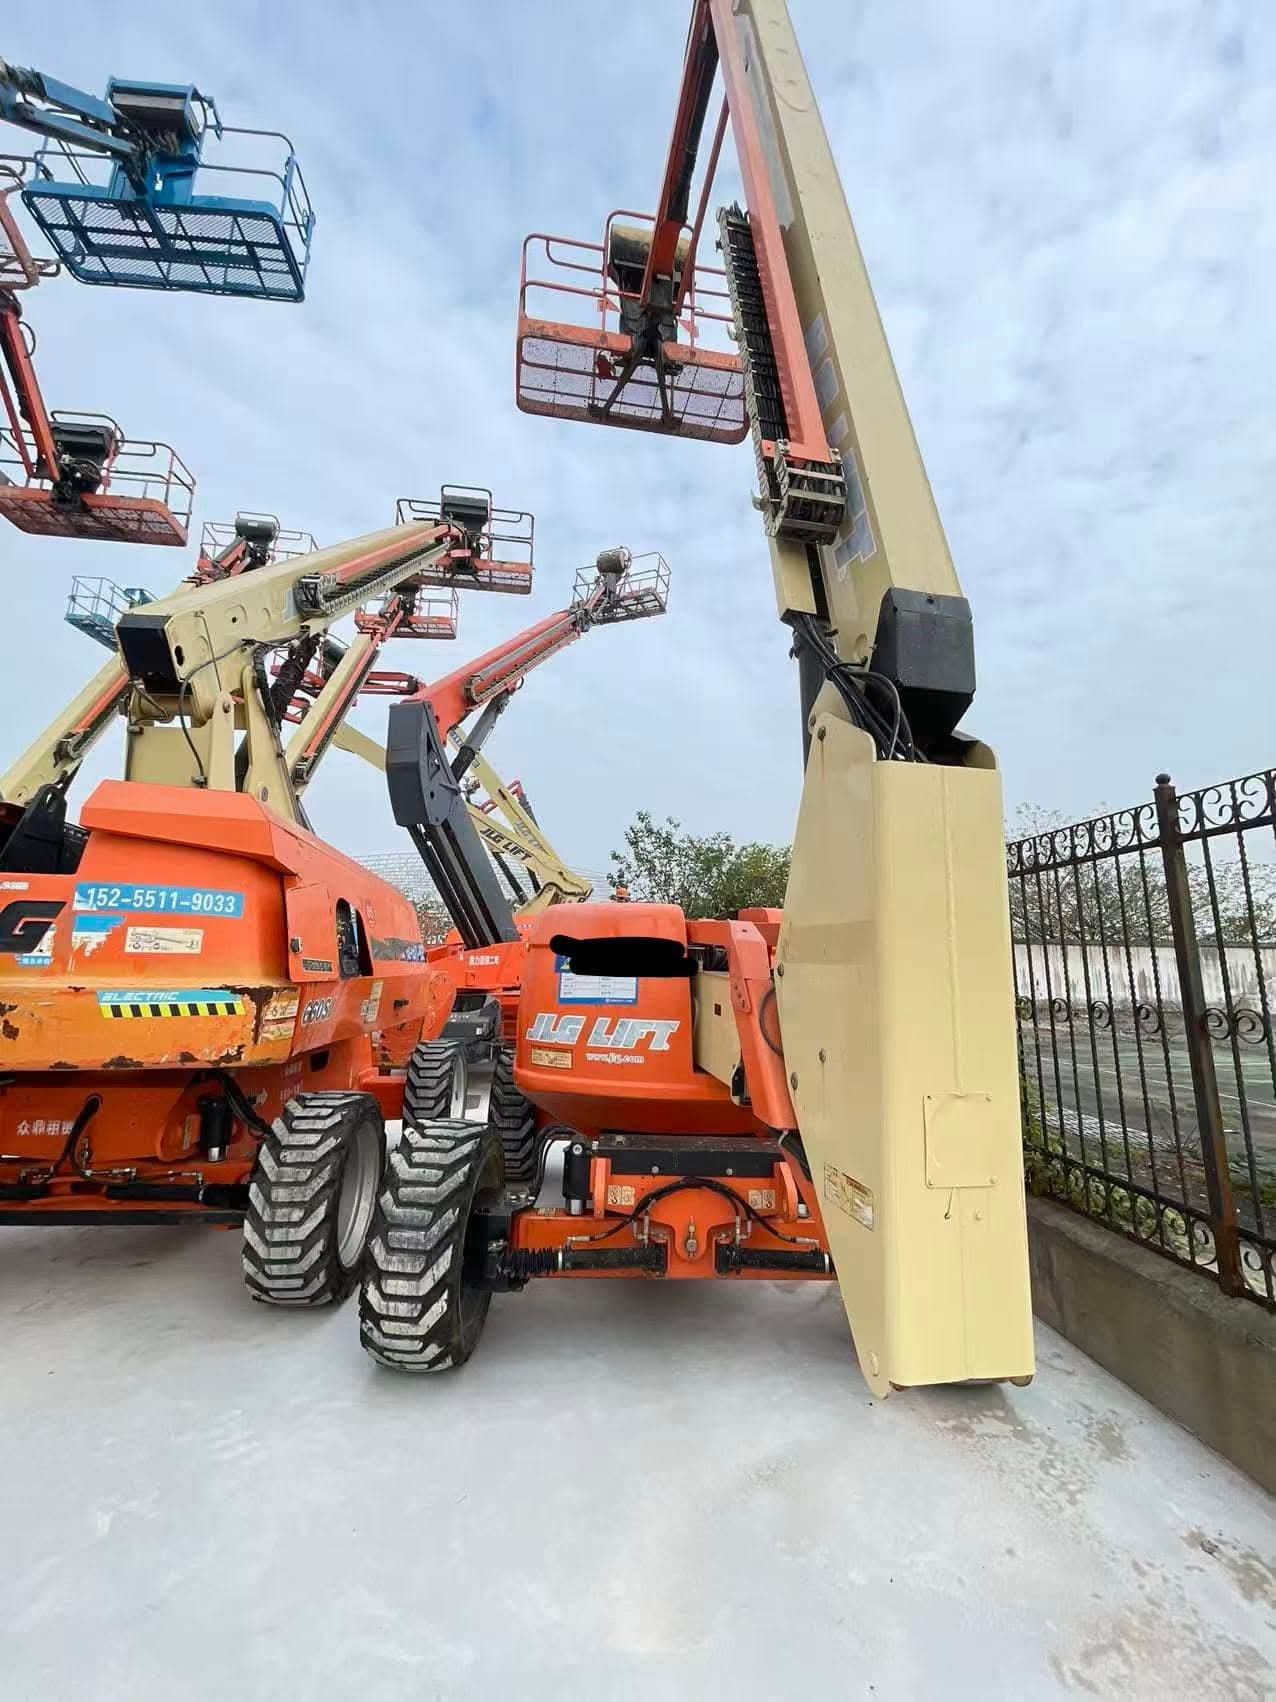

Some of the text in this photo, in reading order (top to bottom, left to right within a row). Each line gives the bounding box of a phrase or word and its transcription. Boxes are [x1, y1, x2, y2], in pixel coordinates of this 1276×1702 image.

[480, 828, 504, 844] JLG
[503, 843, 532, 861] LIFT
[86, 887, 236, 913] 152-5511-9033
[104, 993, 178, 1001] ELECTRIC
[526, 1013, 681, 1051] JLG LIFT
